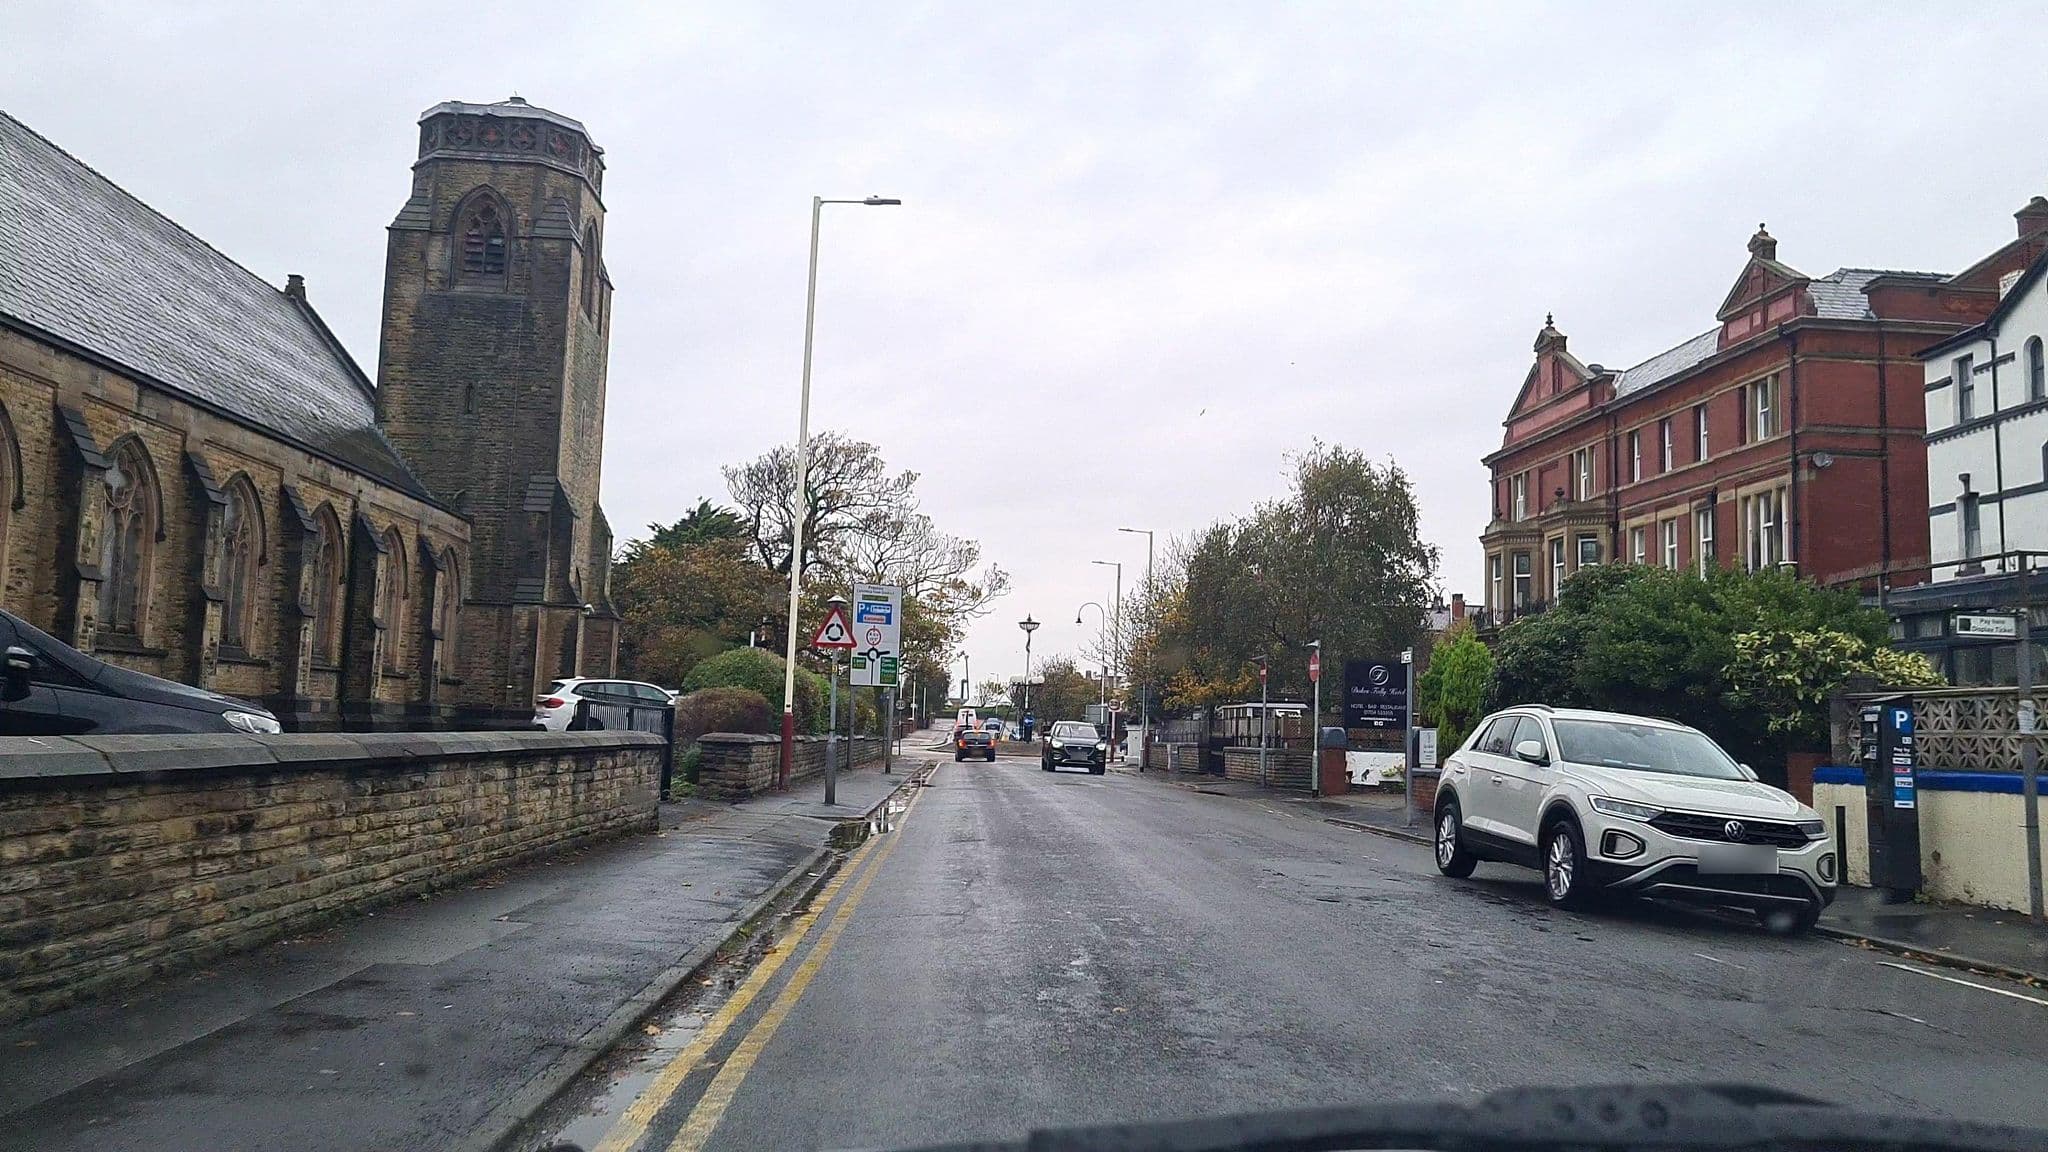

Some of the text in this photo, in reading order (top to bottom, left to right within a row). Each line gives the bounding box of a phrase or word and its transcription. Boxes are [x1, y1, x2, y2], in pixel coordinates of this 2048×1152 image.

[858, 603, 866, 615] P
[1972, 625, 1994, 633] Display
[1895, 710, 1908, 729] P
